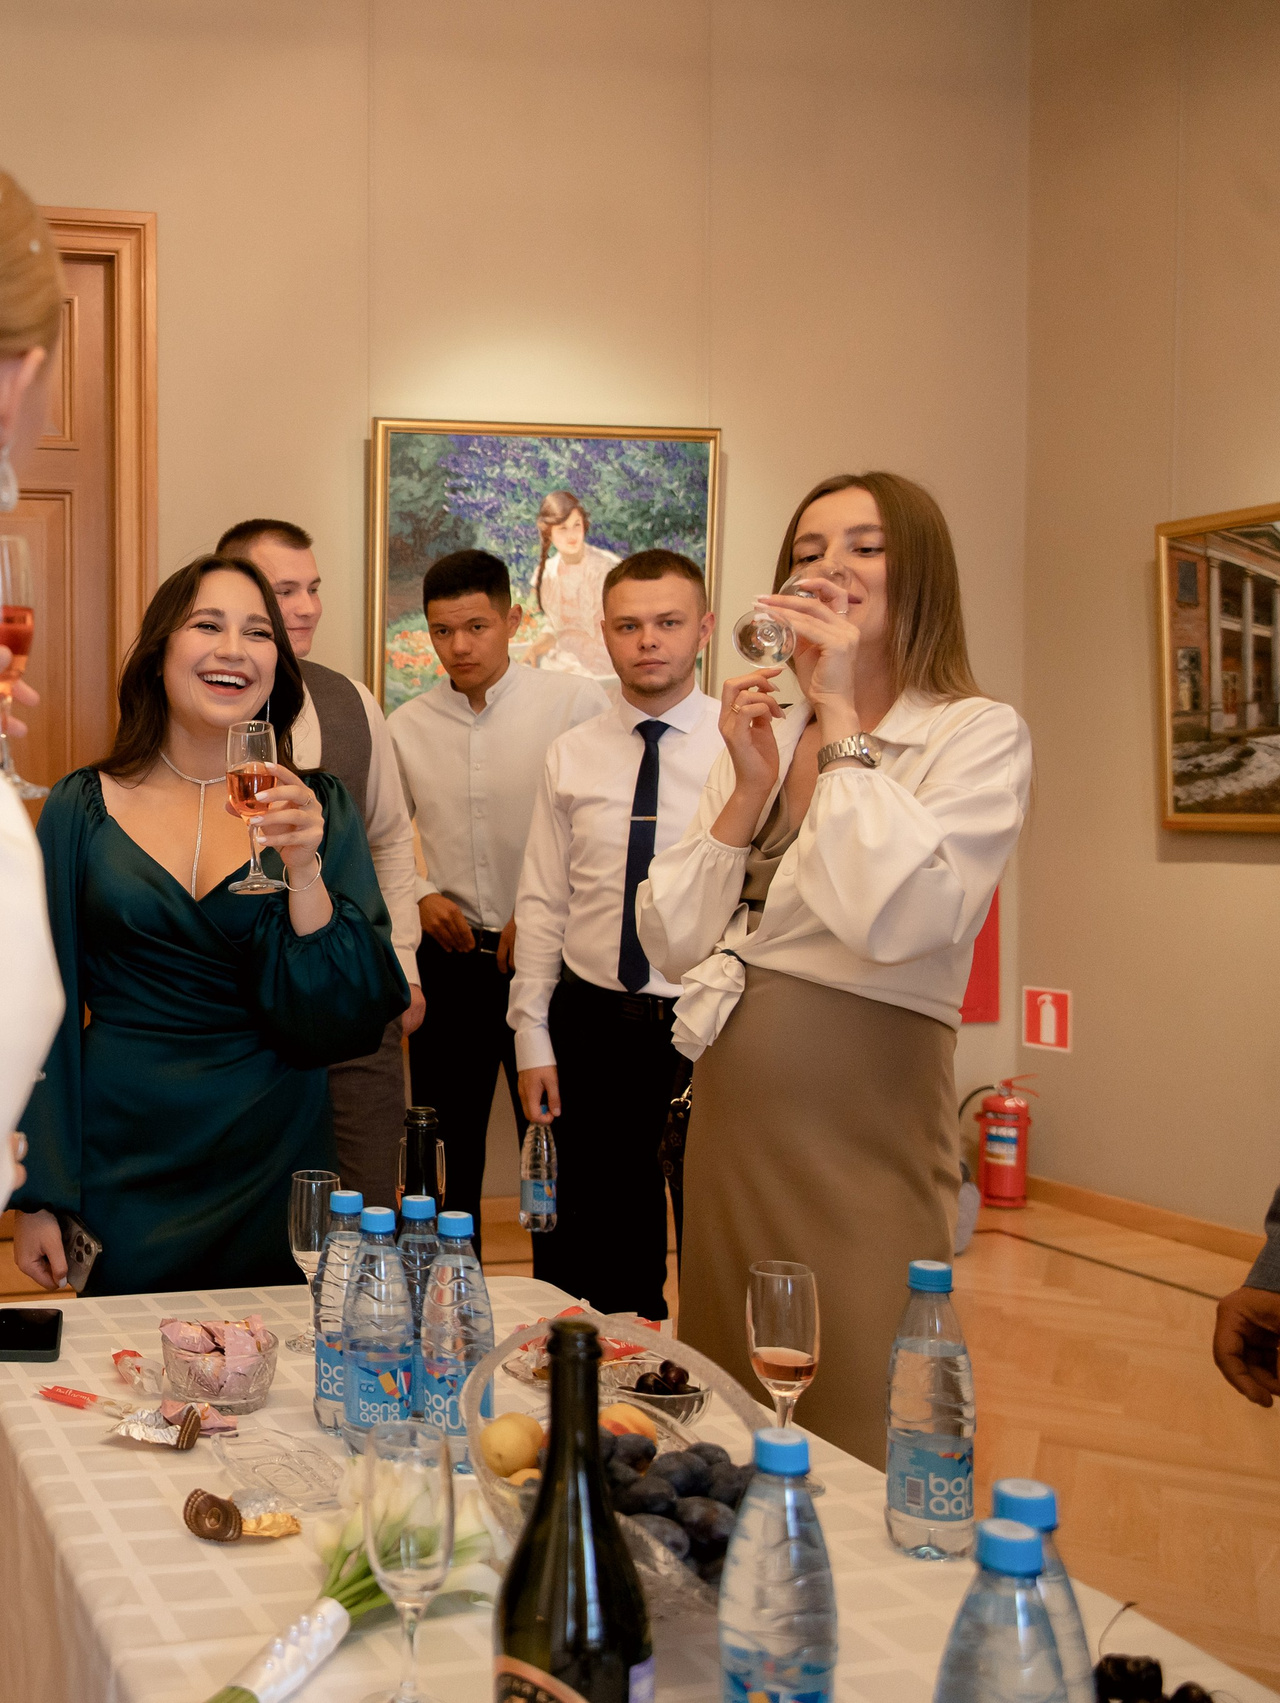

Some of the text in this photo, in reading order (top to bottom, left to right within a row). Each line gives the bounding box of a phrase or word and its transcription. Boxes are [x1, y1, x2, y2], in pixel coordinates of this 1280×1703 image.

[320, 1357, 344, 1381] bo
[359, 1397, 400, 1414] bona
[424, 1385, 461, 1412] bon
[424, 1405, 468, 1433] aqu
[928, 1472, 974, 1496] bon
[928, 1495, 974, 1518] aqu
